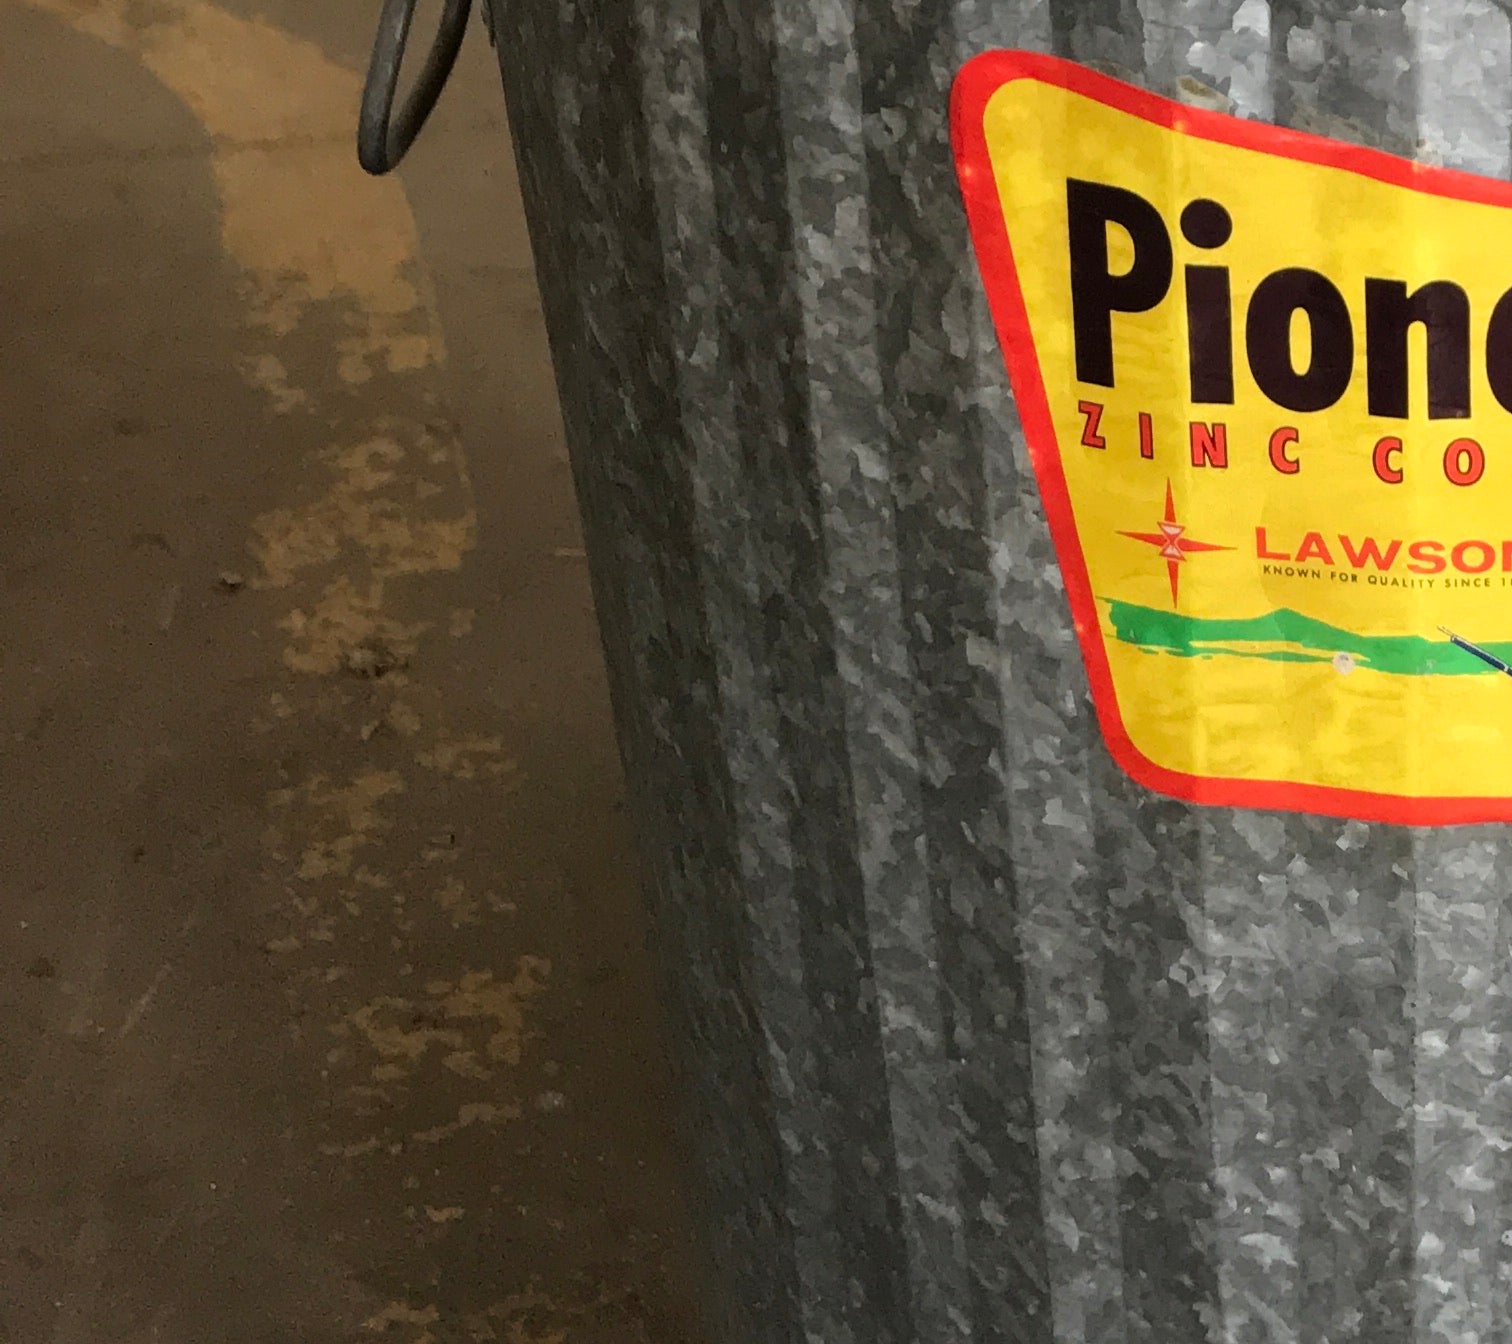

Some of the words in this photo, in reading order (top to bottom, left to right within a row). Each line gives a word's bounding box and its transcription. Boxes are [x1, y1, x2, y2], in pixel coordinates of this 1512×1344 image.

[1077, 399, 1301, 475] ZINC
[1263, 564, 1321, 580] KNOWN
[1330, 570, 1359, 583] FOR
[1367, 574, 1435, 589] QUALITY
[1444, 577, 1491, 589] SINCE
